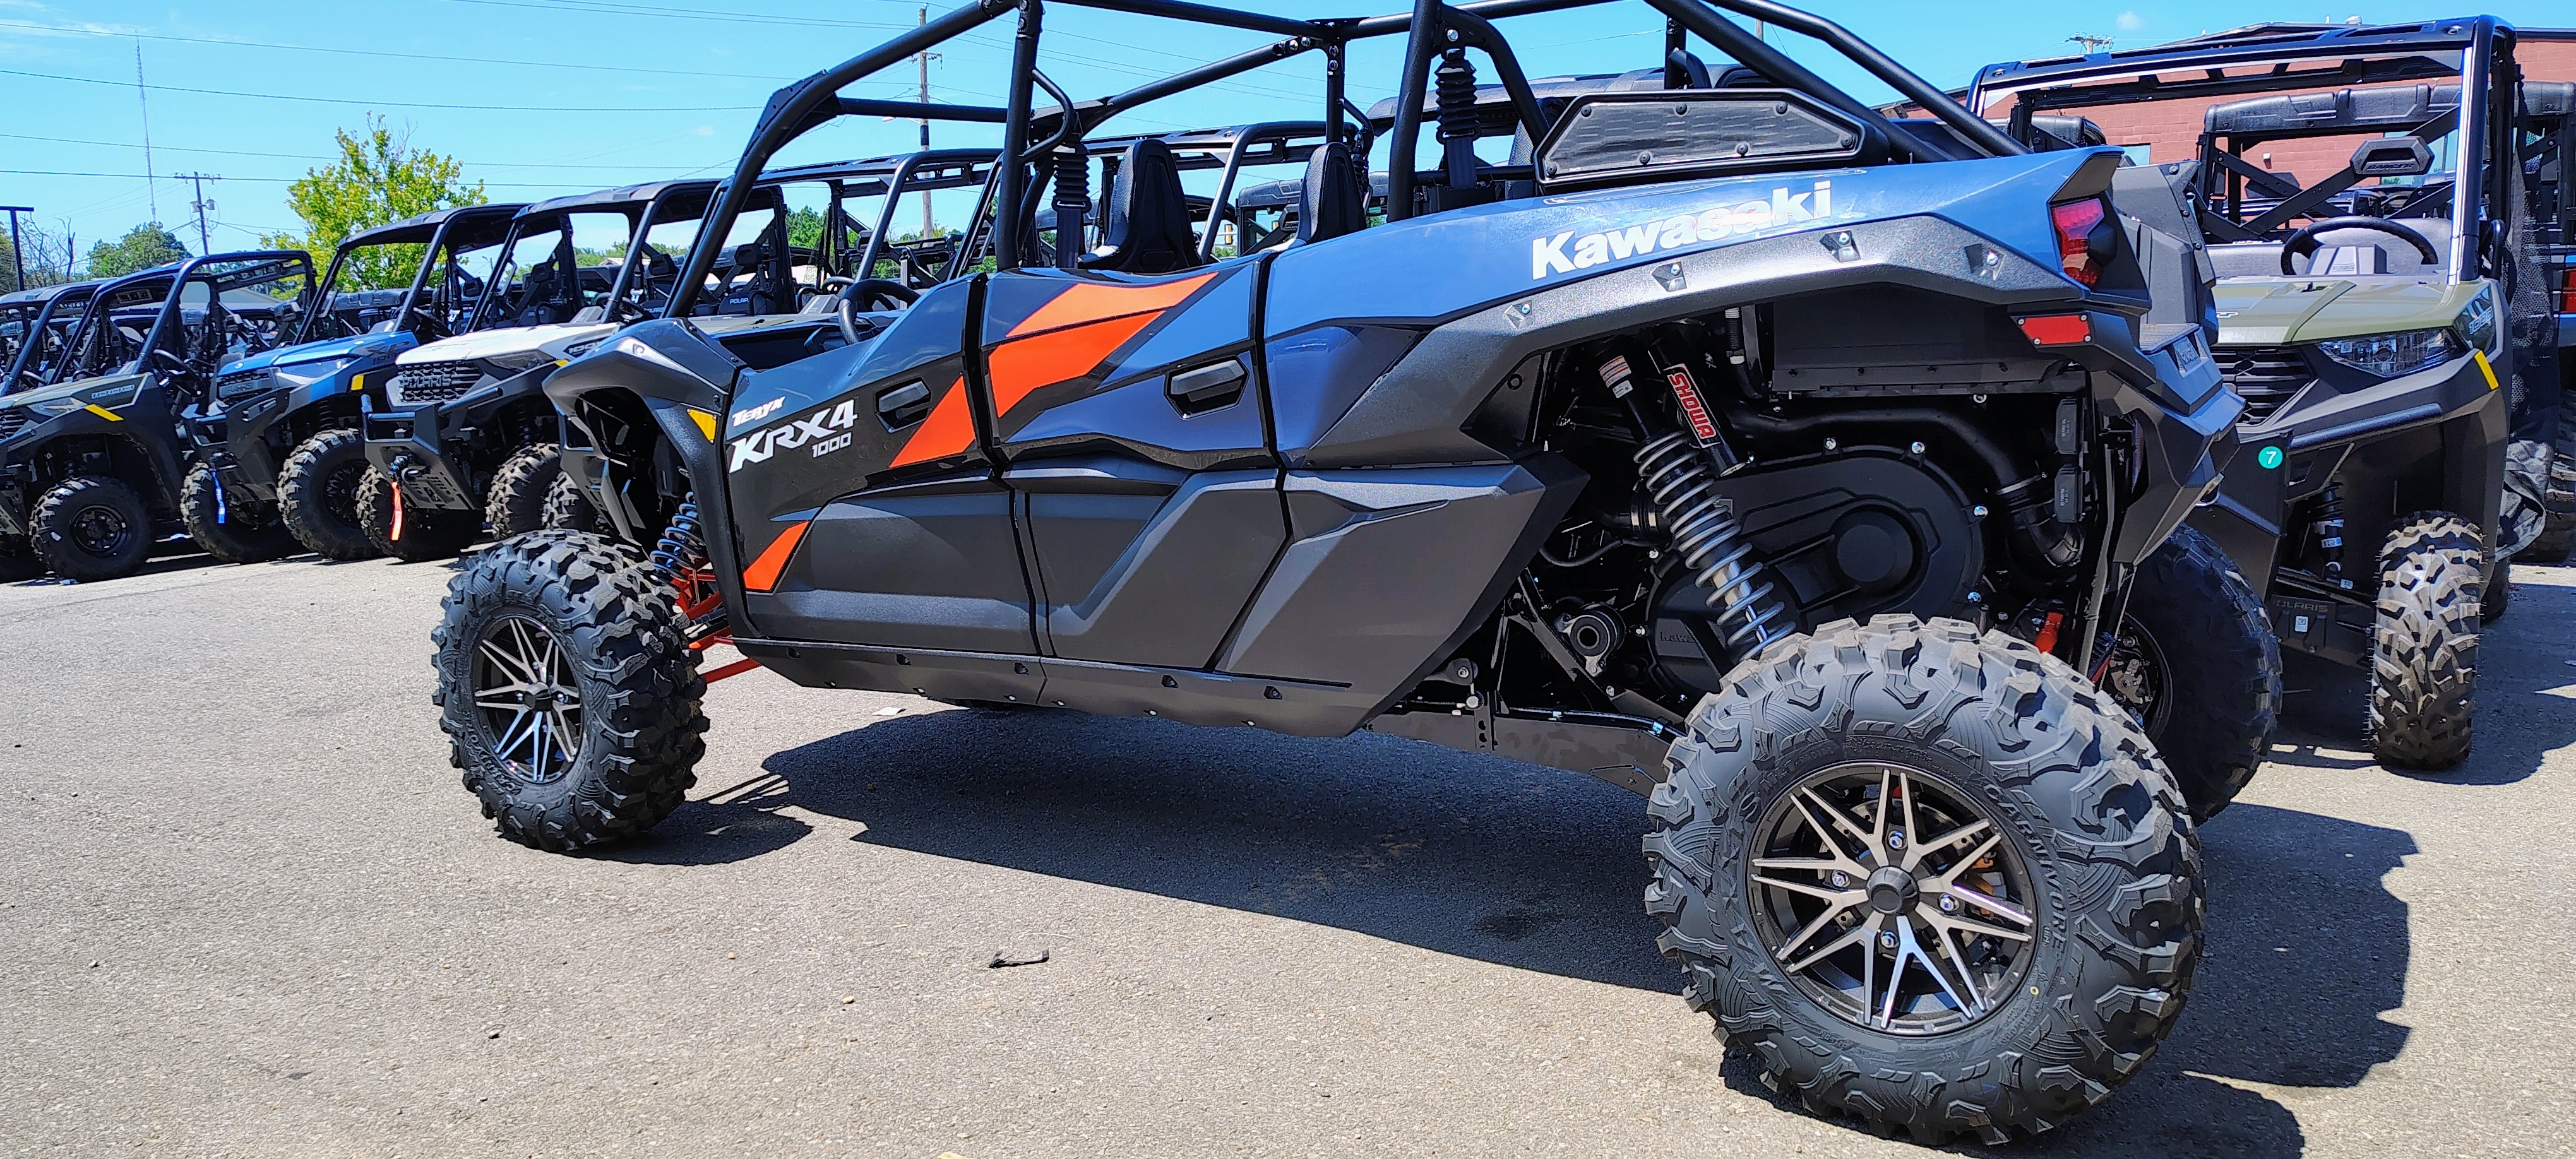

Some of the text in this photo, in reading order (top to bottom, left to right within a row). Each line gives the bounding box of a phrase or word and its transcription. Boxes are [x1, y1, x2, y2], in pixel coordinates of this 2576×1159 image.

[1532, 181, 1831, 280] Kawasaki
[729, 399, 858, 473] KRX4
[1667, 372, 1717, 439] SHOWA
[812, 432, 852, 458] 1000
[2265, 450, 2277, 465] 7
[1982, 783, 2068, 954] CARNIVORE
